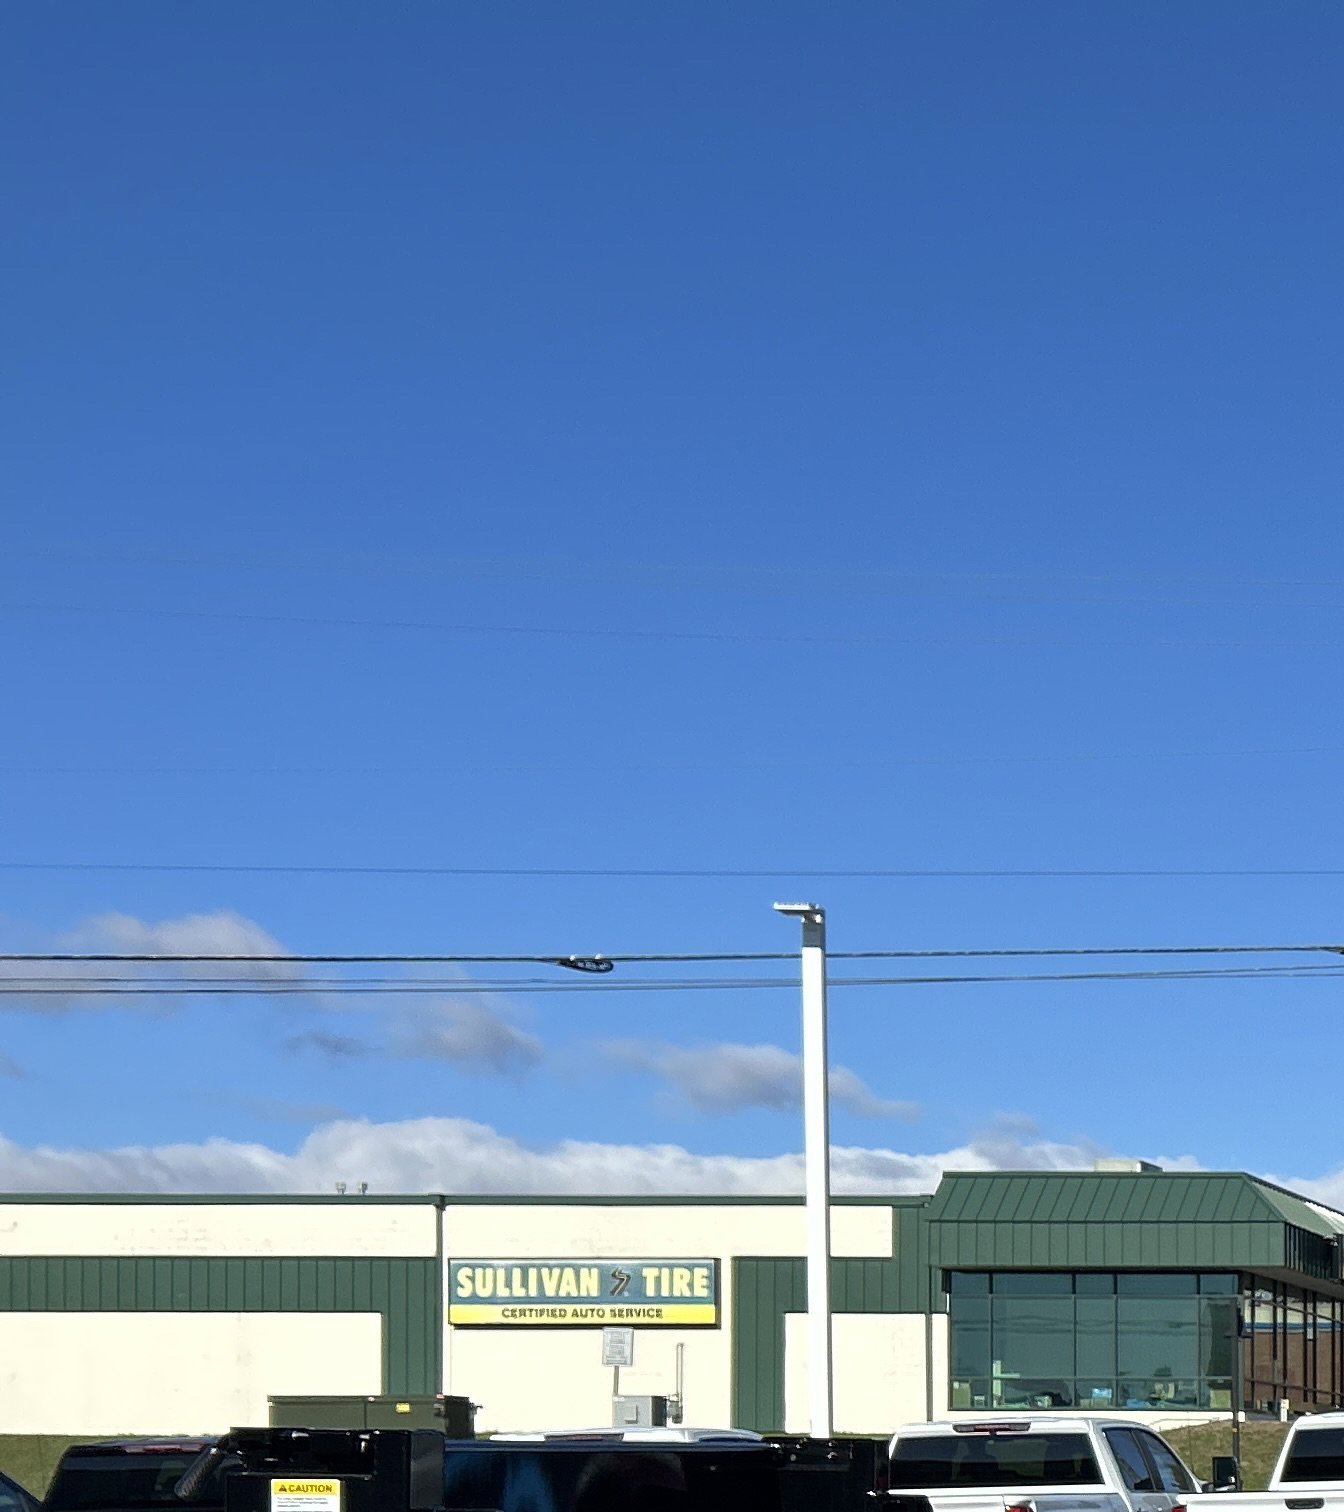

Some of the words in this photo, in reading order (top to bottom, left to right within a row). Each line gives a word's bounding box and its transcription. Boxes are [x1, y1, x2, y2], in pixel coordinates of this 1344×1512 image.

[456, 1266, 599, 1298] SULLIVAN
[641, 1266, 709, 1298] TIRE
[501, 1307, 567, 1319] CERTIFIED
[571, 1307, 606, 1319] AUTO
[610, 1307, 664, 1319] SERVICE
[288, 1484, 333, 1493] CAUTION
